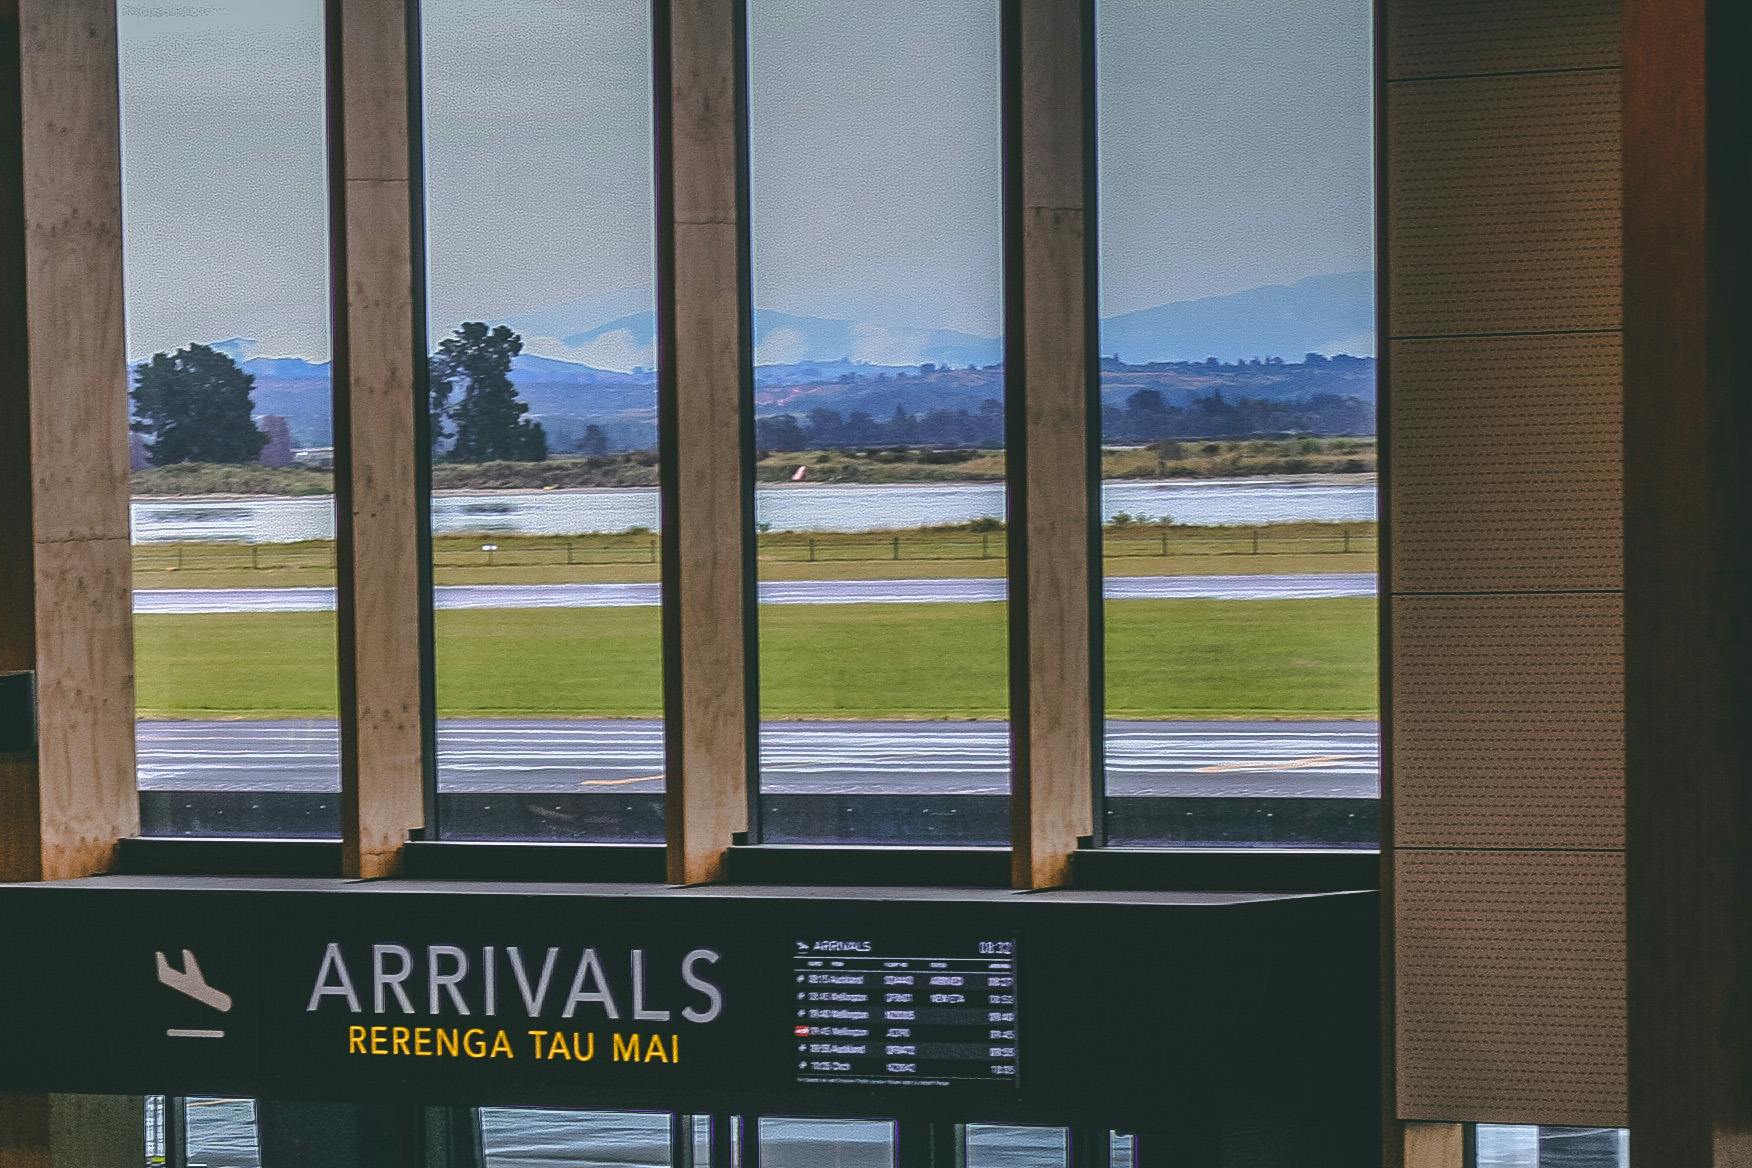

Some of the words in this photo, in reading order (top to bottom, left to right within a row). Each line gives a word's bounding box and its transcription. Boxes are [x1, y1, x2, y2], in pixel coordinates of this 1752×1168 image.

[813, 941, 872, 952] ARRIVALS
[306, 942, 723, 1023] ARRIVALS
[348, 1025, 515, 1060] RERENGA
[528, 1029, 595, 1062] TAU
[612, 1032, 680, 1064] MAI
